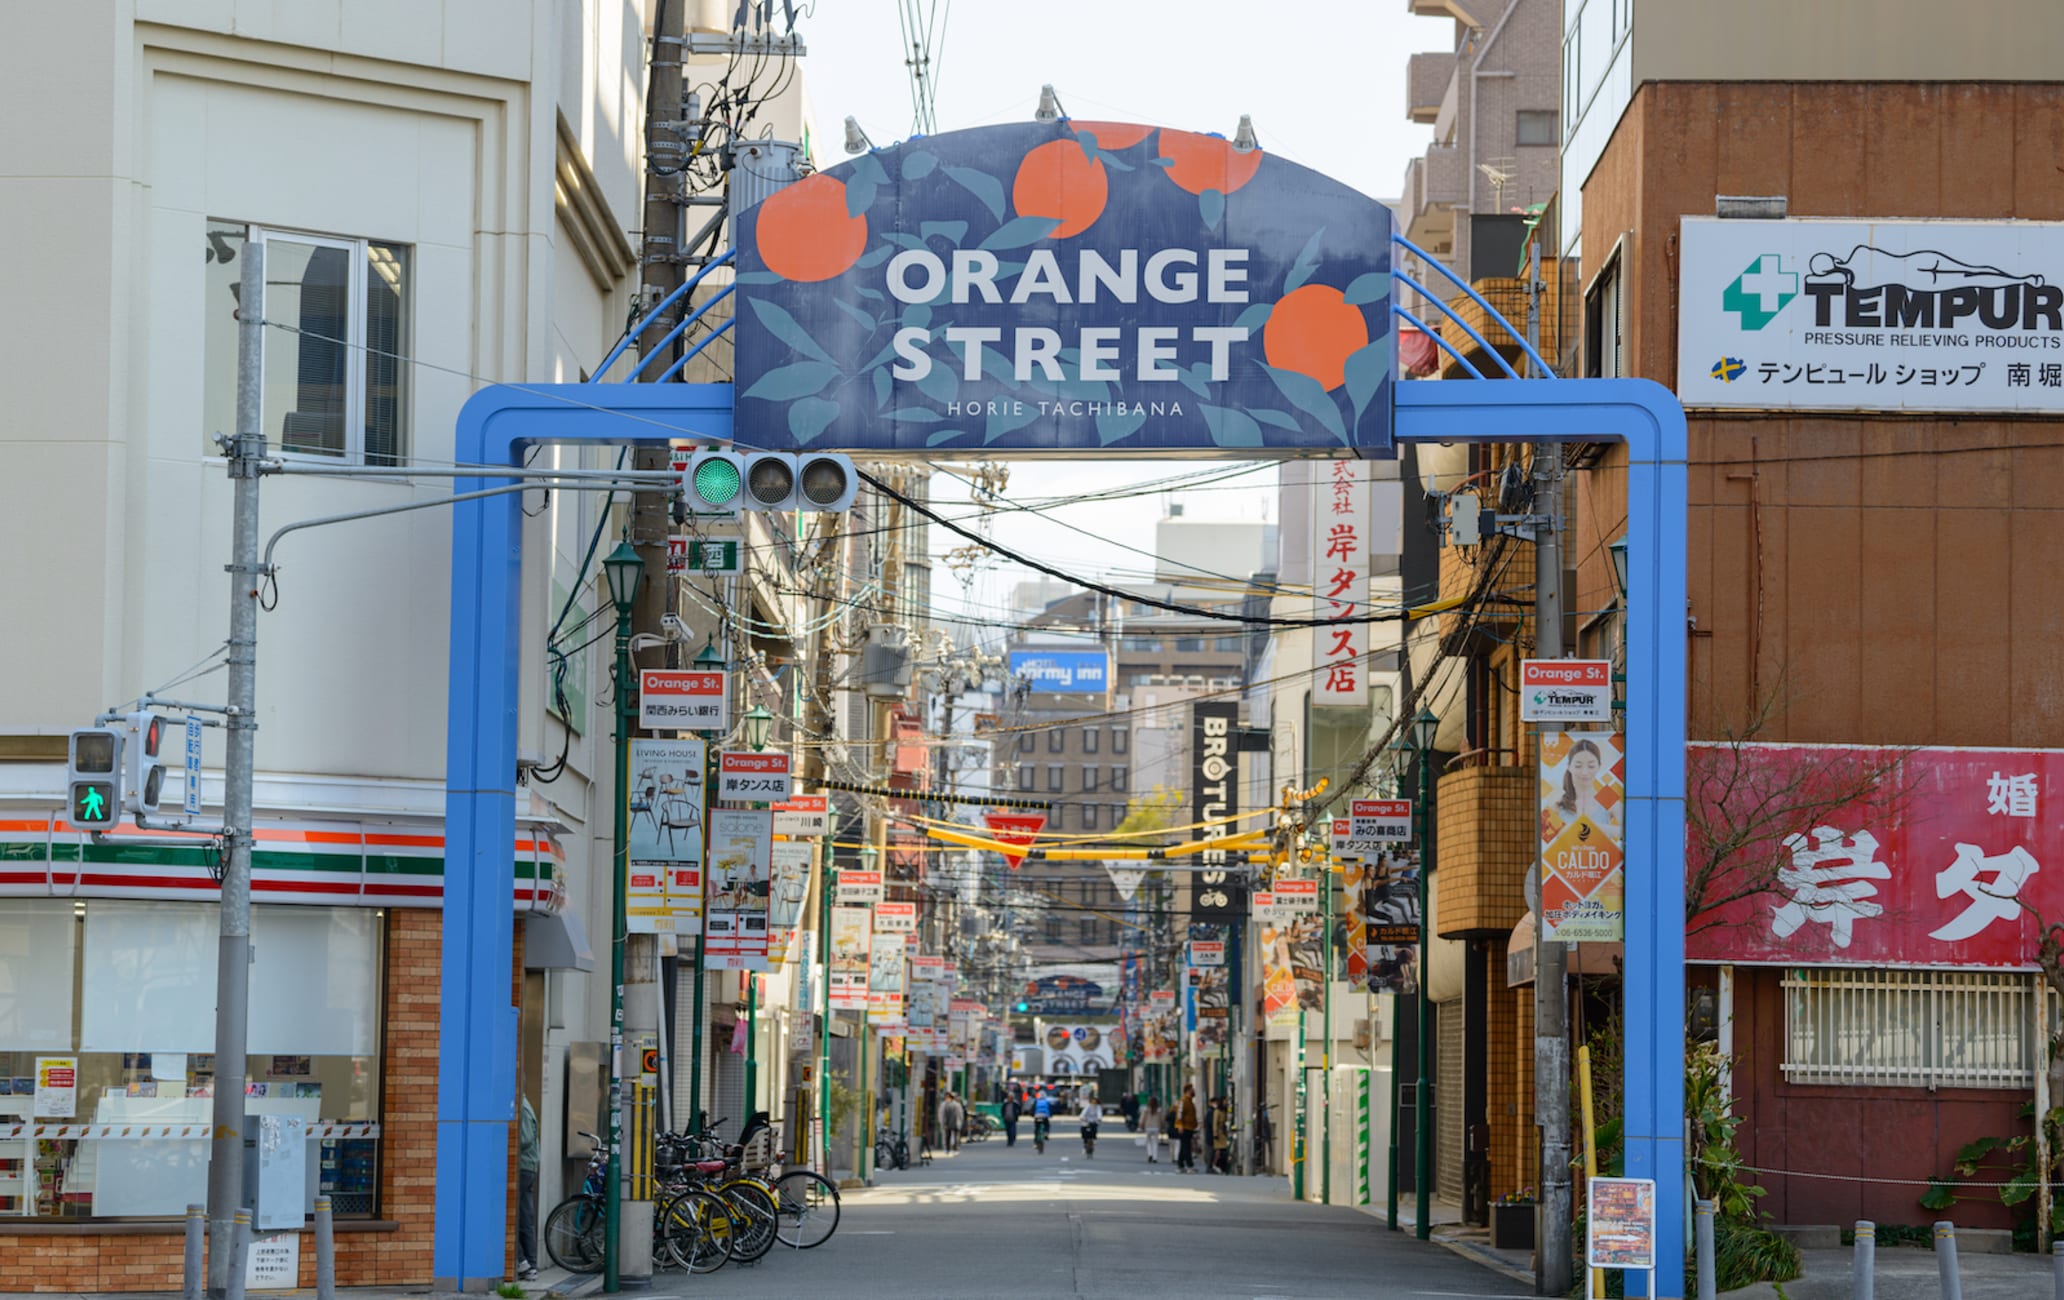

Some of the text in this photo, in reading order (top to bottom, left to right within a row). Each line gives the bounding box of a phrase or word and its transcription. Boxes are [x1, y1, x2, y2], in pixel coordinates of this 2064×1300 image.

[886, 247, 1250, 305] ORANGE
[1803, 281, 2064, 330] TEMPUR
[1804, 332, 2061, 349] PRESSURE RELIEVING PRODUCTS
[892, 326, 1250, 383] STREET
[947, 401, 1185, 418] HORIE TACHIBANA
[1077, 667, 1103, 680] inn
[1527, 666, 1604, 682] Orange St.
[646, 676, 720, 692] Orange St.
[1547, 695, 1594, 705] TEMPUR
[645, 704, 720, 717] 関西みらい銀行
[725, 757, 786, 770] Orange St.
[725, 778, 785, 792] 岸タンス店
[1986, 771, 2039, 818] 婚
[1355, 803, 1408, 815] Orange St.
[1557, 850, 1610, 870] CALDO
